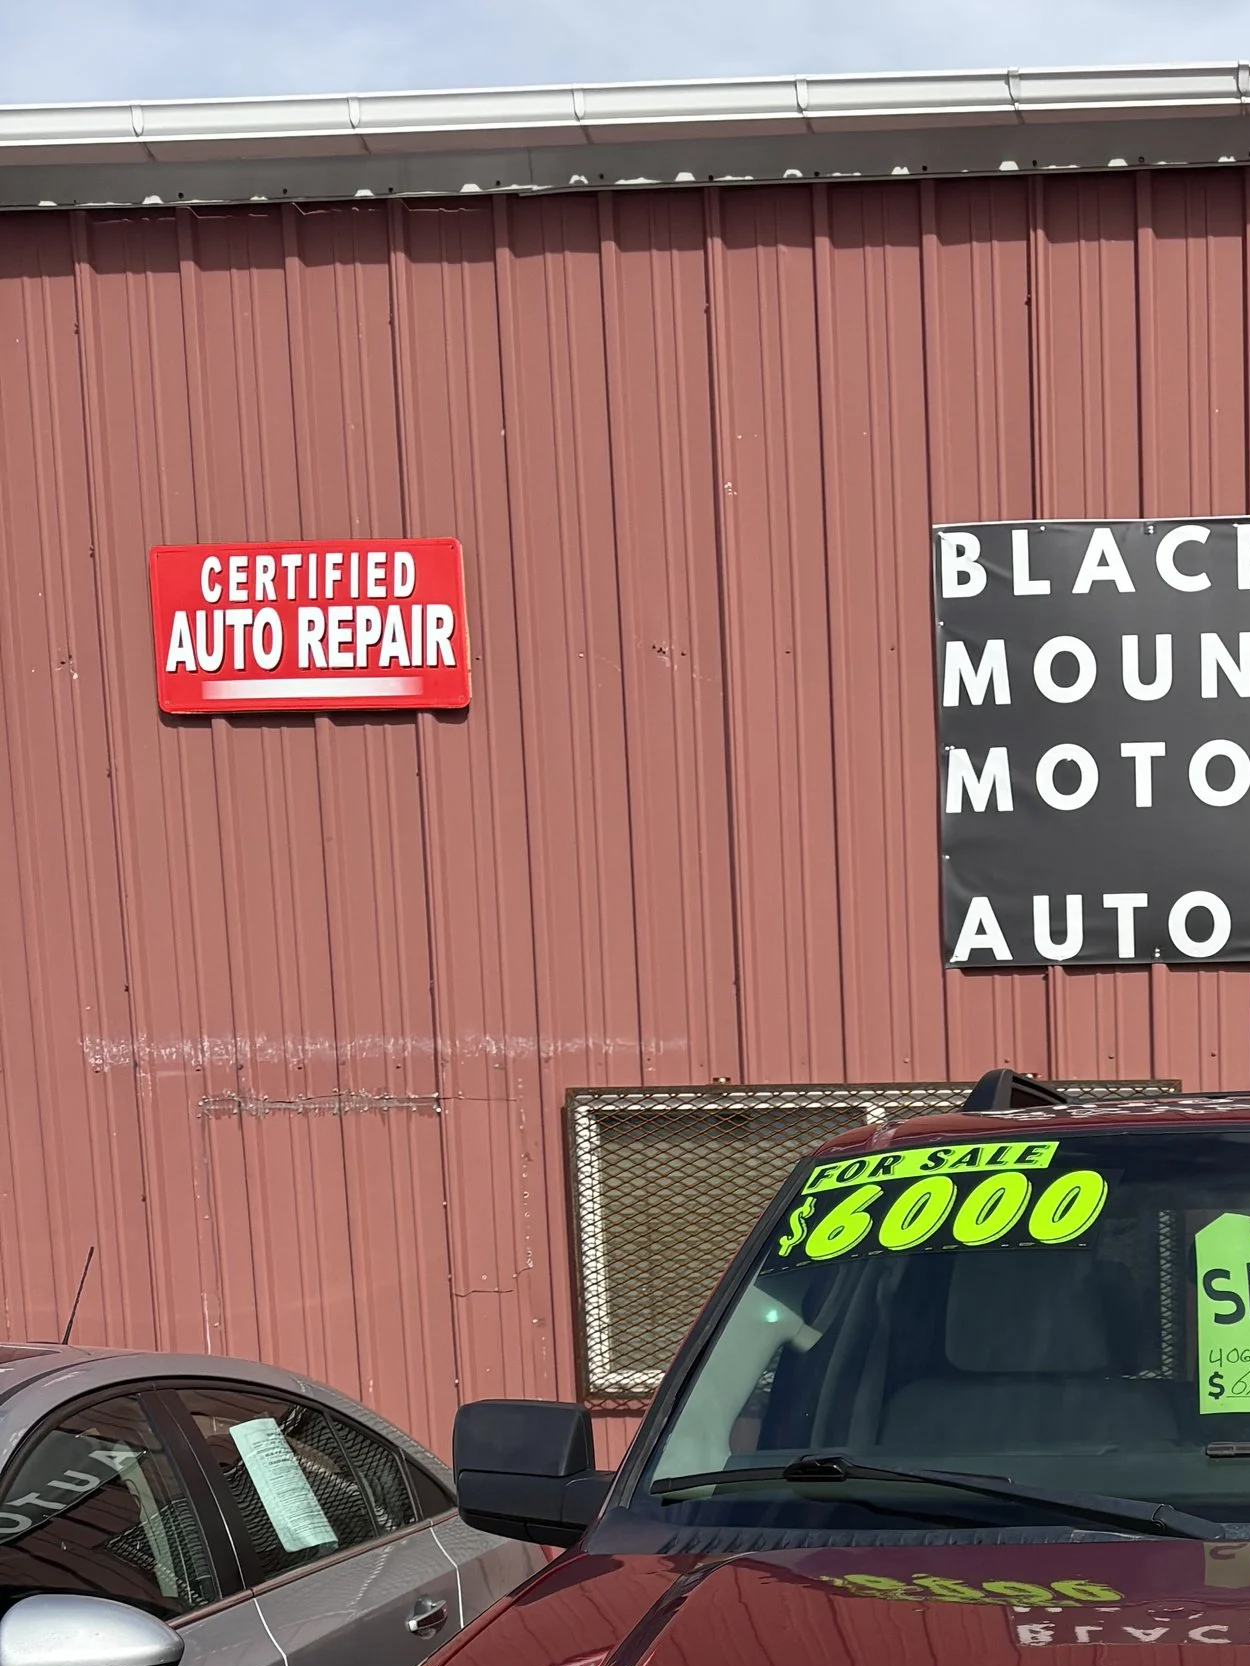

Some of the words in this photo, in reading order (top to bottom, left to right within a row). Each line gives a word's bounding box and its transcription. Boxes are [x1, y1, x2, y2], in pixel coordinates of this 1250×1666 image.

[201, 551, 416, 604] CERTIFIED
[165, 607, 283, 672] AUTO
[298, 604, 456, 669] REPAIR
[953, 890, 1232, 962] AUTO
[807, 1155, 905, 1189] FOR
[919, 1144, 1052, 1171] SALE
[778, 1170, 1108, 1261] $6000
